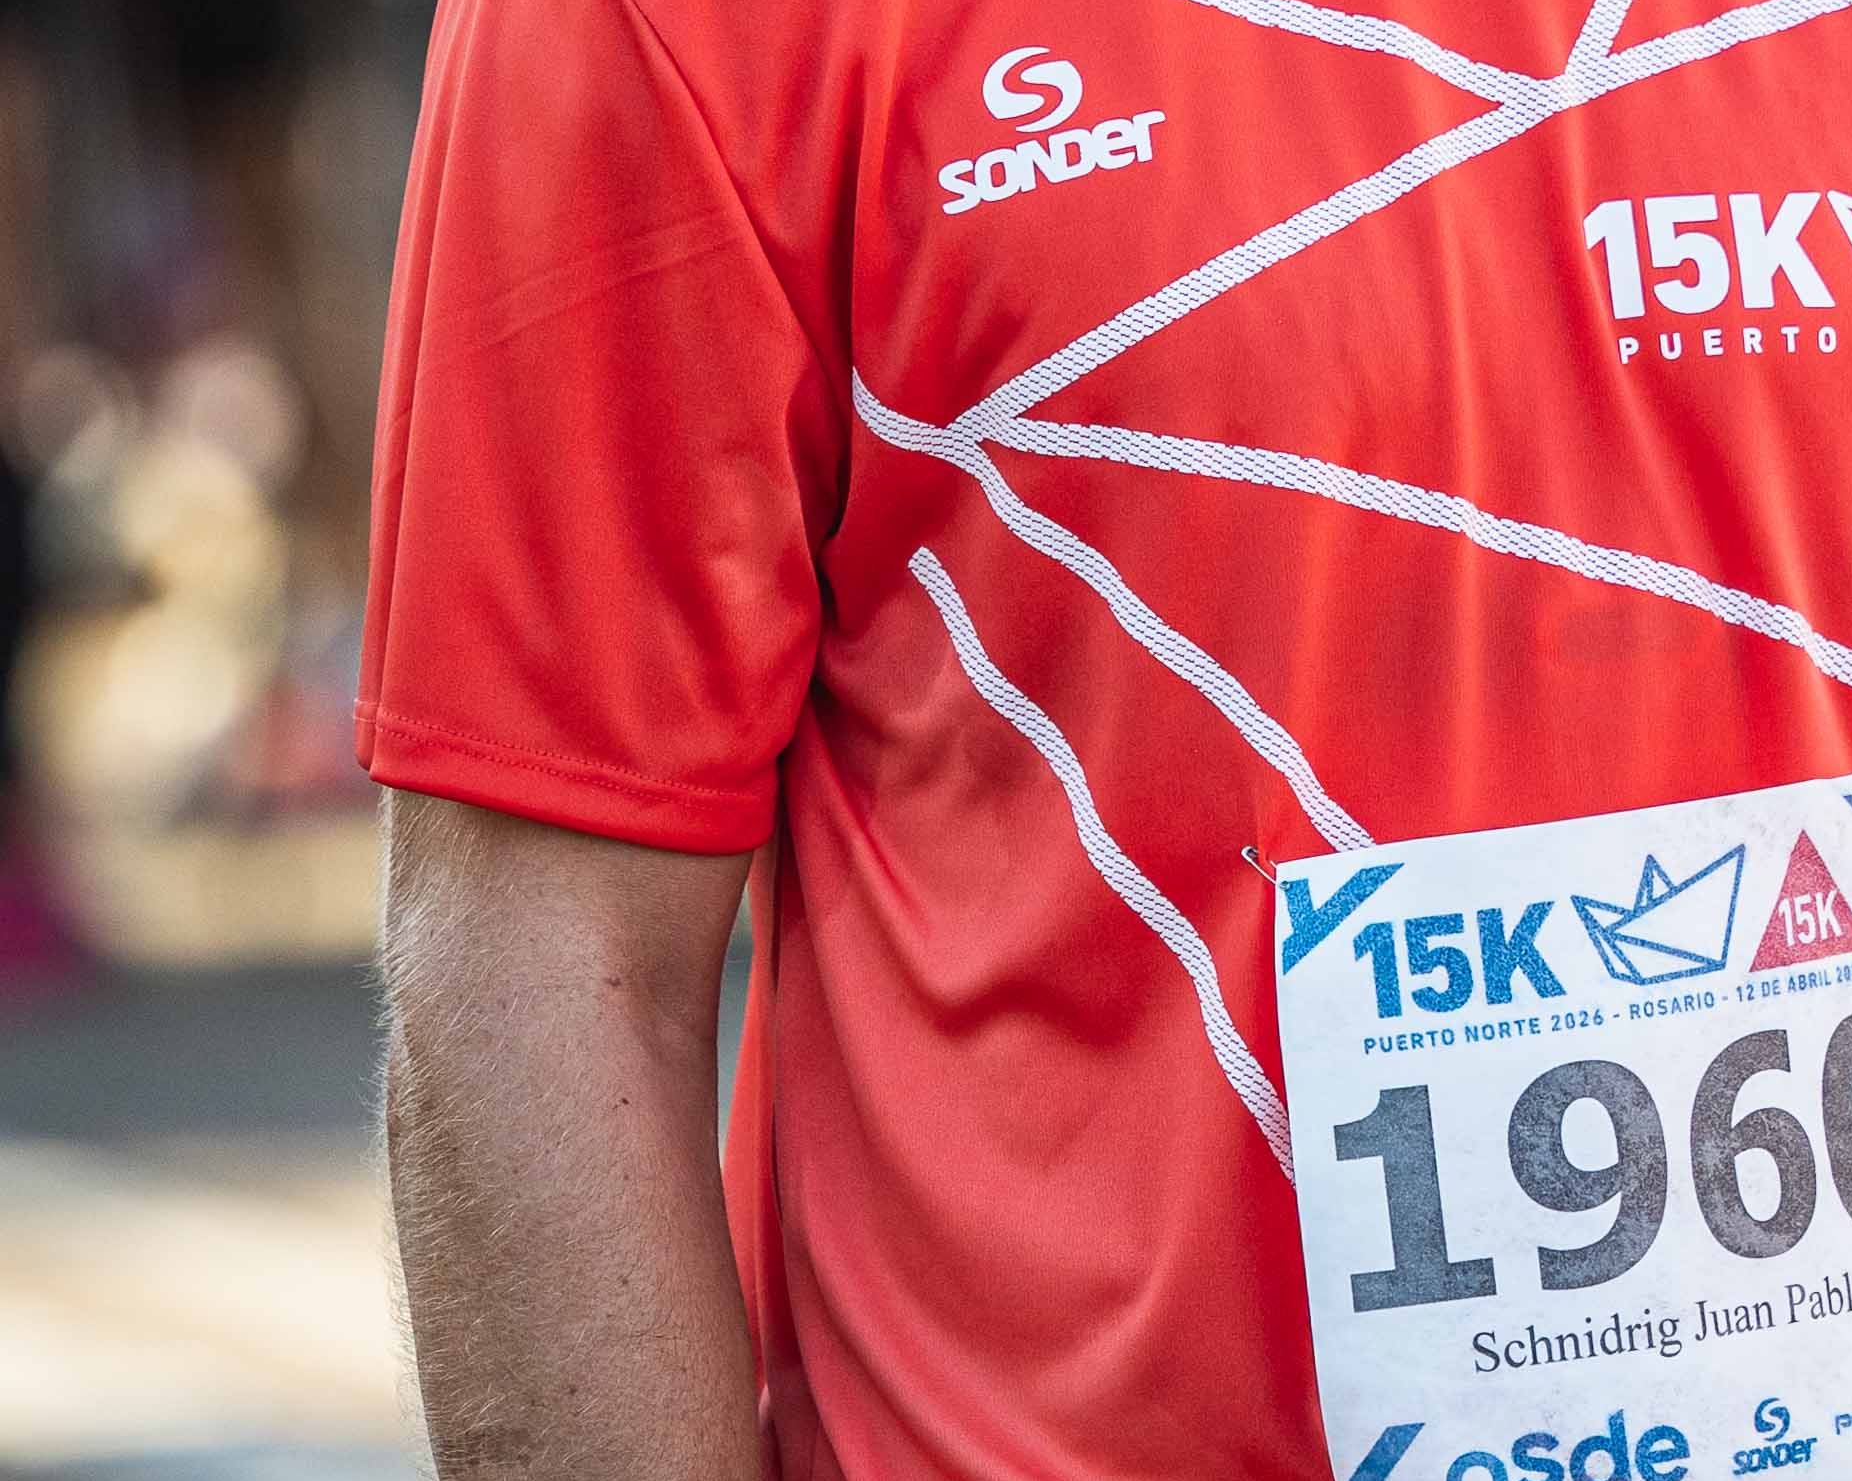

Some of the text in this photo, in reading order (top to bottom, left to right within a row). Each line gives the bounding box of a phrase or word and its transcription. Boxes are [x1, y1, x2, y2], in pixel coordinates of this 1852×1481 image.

[1583, 192, 1836, 319] 15K
[1619, 326, 1836, 364] PUERTO
[1779, 890, 1843, 947] 15K
[1353, 901, 1567, 1018] 15K
[1364, 1028, 1455, 1054] PUERTO
[1465, 1017, 1541, 1043] NORTE
[1551, 1008, 1604, 1032] 2026
[1629, 992, 1715, 1020] ROSARIO
[1736, 985, 1755, 1002] 12
[1762, 979, 1782, 997] DE
[1787, 969, 1832, 993] ABRIL
[1472, 1308, 1683, 1373] Schnidrig
[1695, 1298, 1774, 1341] Juan
